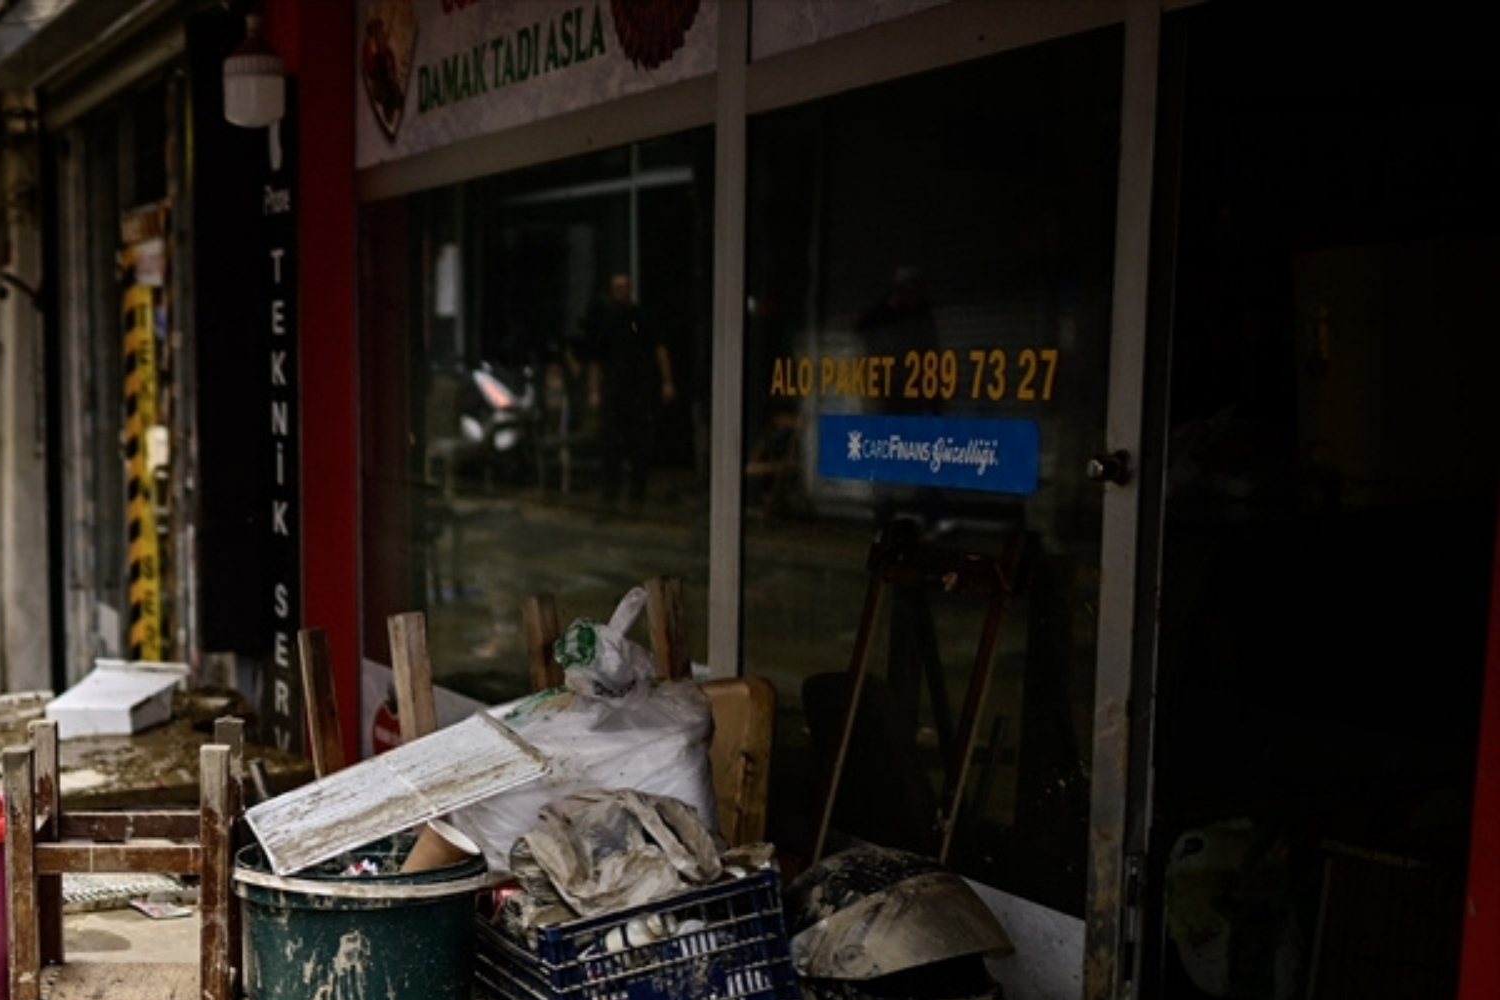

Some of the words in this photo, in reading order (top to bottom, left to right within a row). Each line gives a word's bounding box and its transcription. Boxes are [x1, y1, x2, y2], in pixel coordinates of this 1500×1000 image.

[417, 42, 488, 114] DAMAK
[491, 23, 540, 88] TADI
[544, 3, 606, 73] ASLA
[270, 248, 288, 536] TEKNİK
[770, 357, 814, 397] ALO
[820, 356, 896, 398] PAKET
[903, 350, 958, 399] 289
[969, 349, 1007, 400] 73
[1016, 348, 1059, 400] 27
